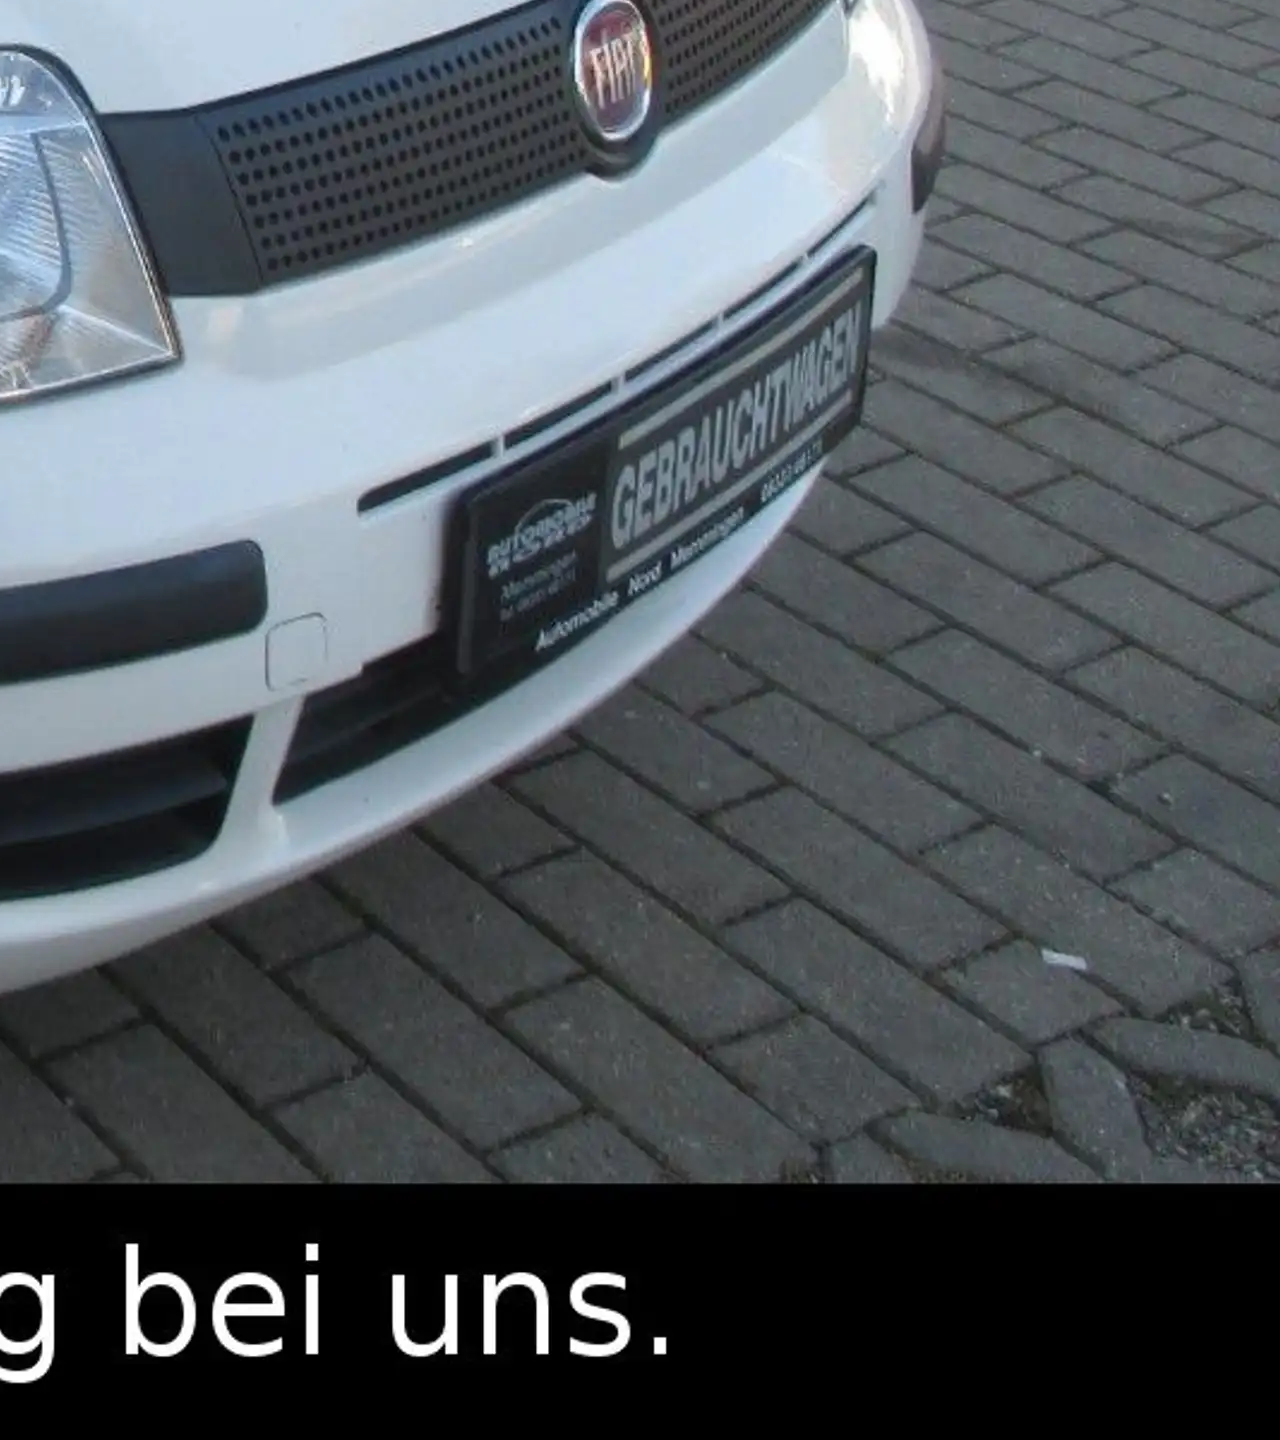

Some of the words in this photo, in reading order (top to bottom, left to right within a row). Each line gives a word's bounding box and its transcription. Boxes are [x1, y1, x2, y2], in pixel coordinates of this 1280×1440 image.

[588, 31, 638, 111] FIAT
[610, 302, 864, 549] GEBRAUCHTWAGEN
[535, 591, 619, 652] Automobile
[627, 562, 663, 597] Nord
